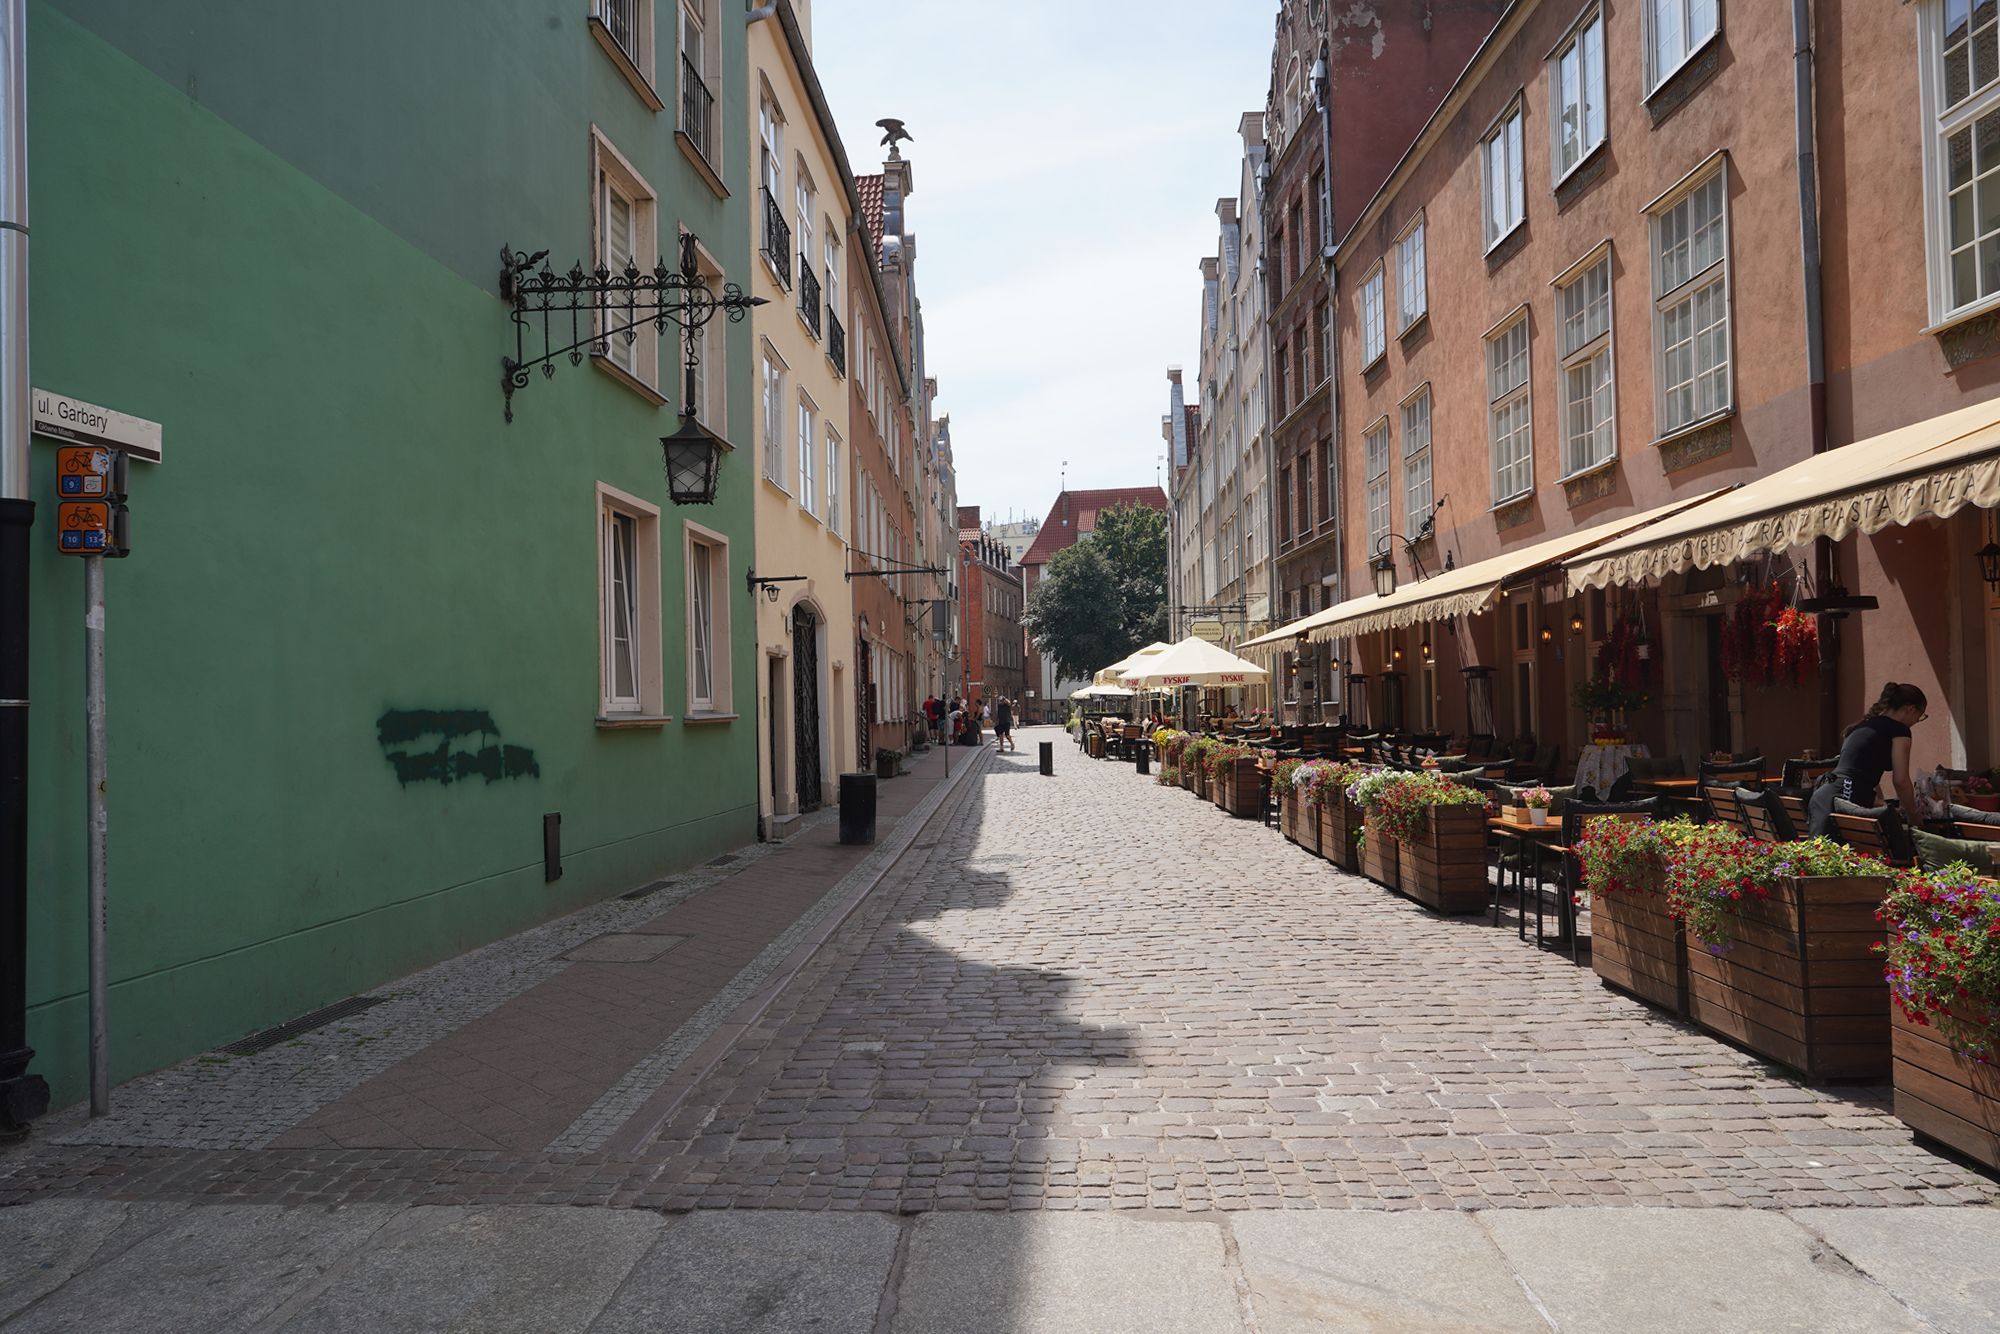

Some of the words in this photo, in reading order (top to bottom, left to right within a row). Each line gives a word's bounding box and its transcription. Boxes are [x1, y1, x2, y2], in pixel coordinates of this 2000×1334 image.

[38, 398, 53, 416] ul.
[57, 401, 108, 433] Garbary
[69, 481, 75, 489] 9
[1822, 495, 1891, 528] PASTA
[1905, 473, 1975, 507] PIZZA
[1220, 674, 1245, 682] TYSKIE
